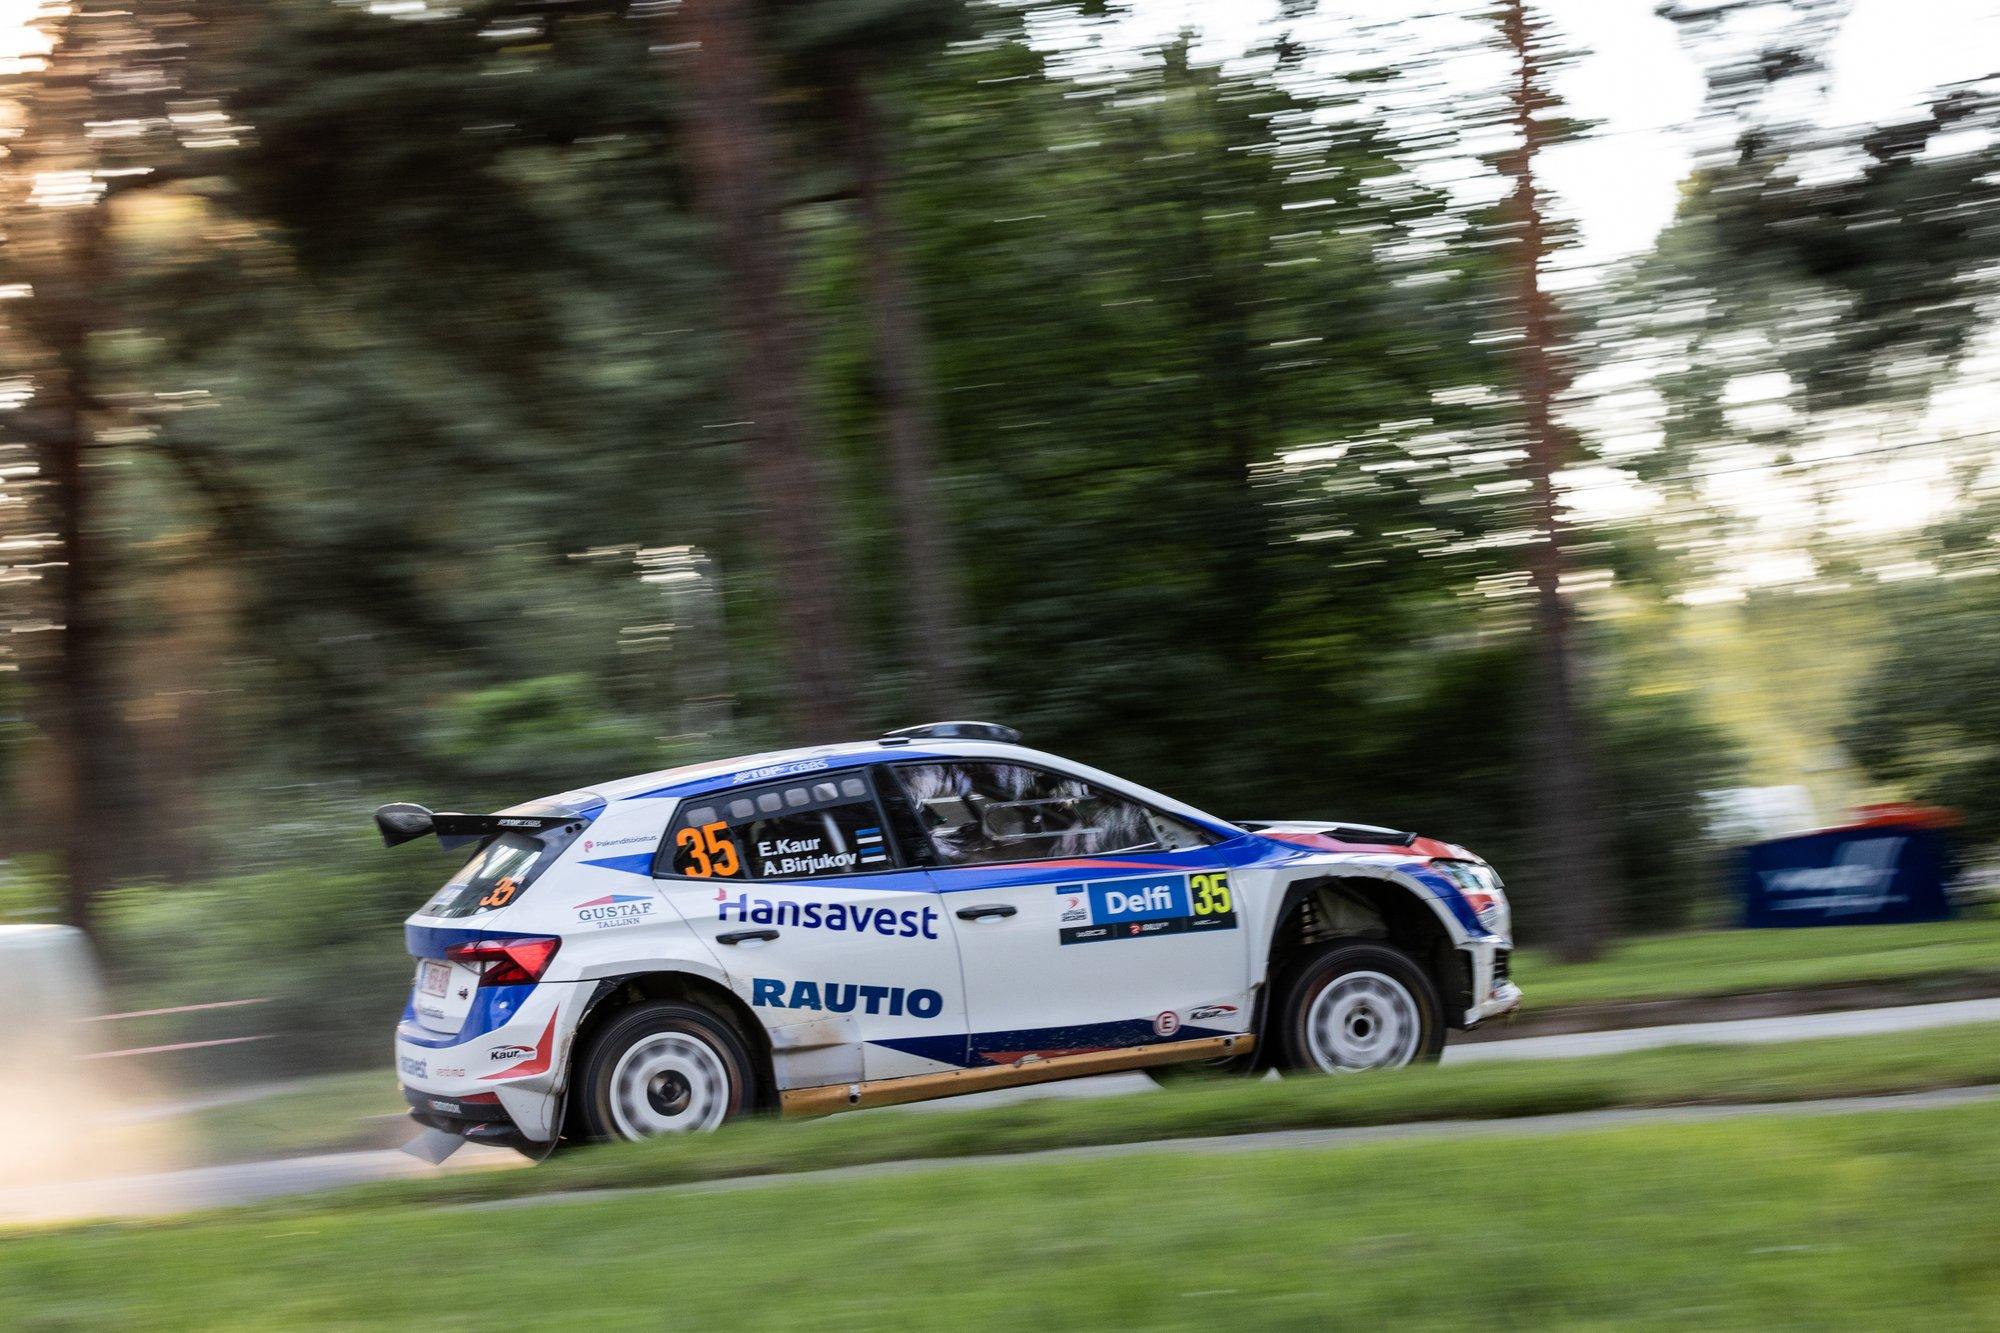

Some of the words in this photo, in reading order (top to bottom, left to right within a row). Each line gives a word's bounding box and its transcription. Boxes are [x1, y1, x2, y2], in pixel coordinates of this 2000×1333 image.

[676, 820, 740, 878] 35
[758, 837, 822, 857] E.Kaur
[763, 851, 857, 876] A.Birjukov
[479, 876, 525, 907] 35
[1105, 884, 1173, 915] Delfi
[1191, 873, 1232, 916] 35
[579, 902, 652, 921] GUSTAF
[597, 917, 640, 929] TALLINN
[717, 892, 938, 940] Hansavest
[752, 977, 944, 1019] RAUTIO
[490, 1050, 520, 1060] Kaur
